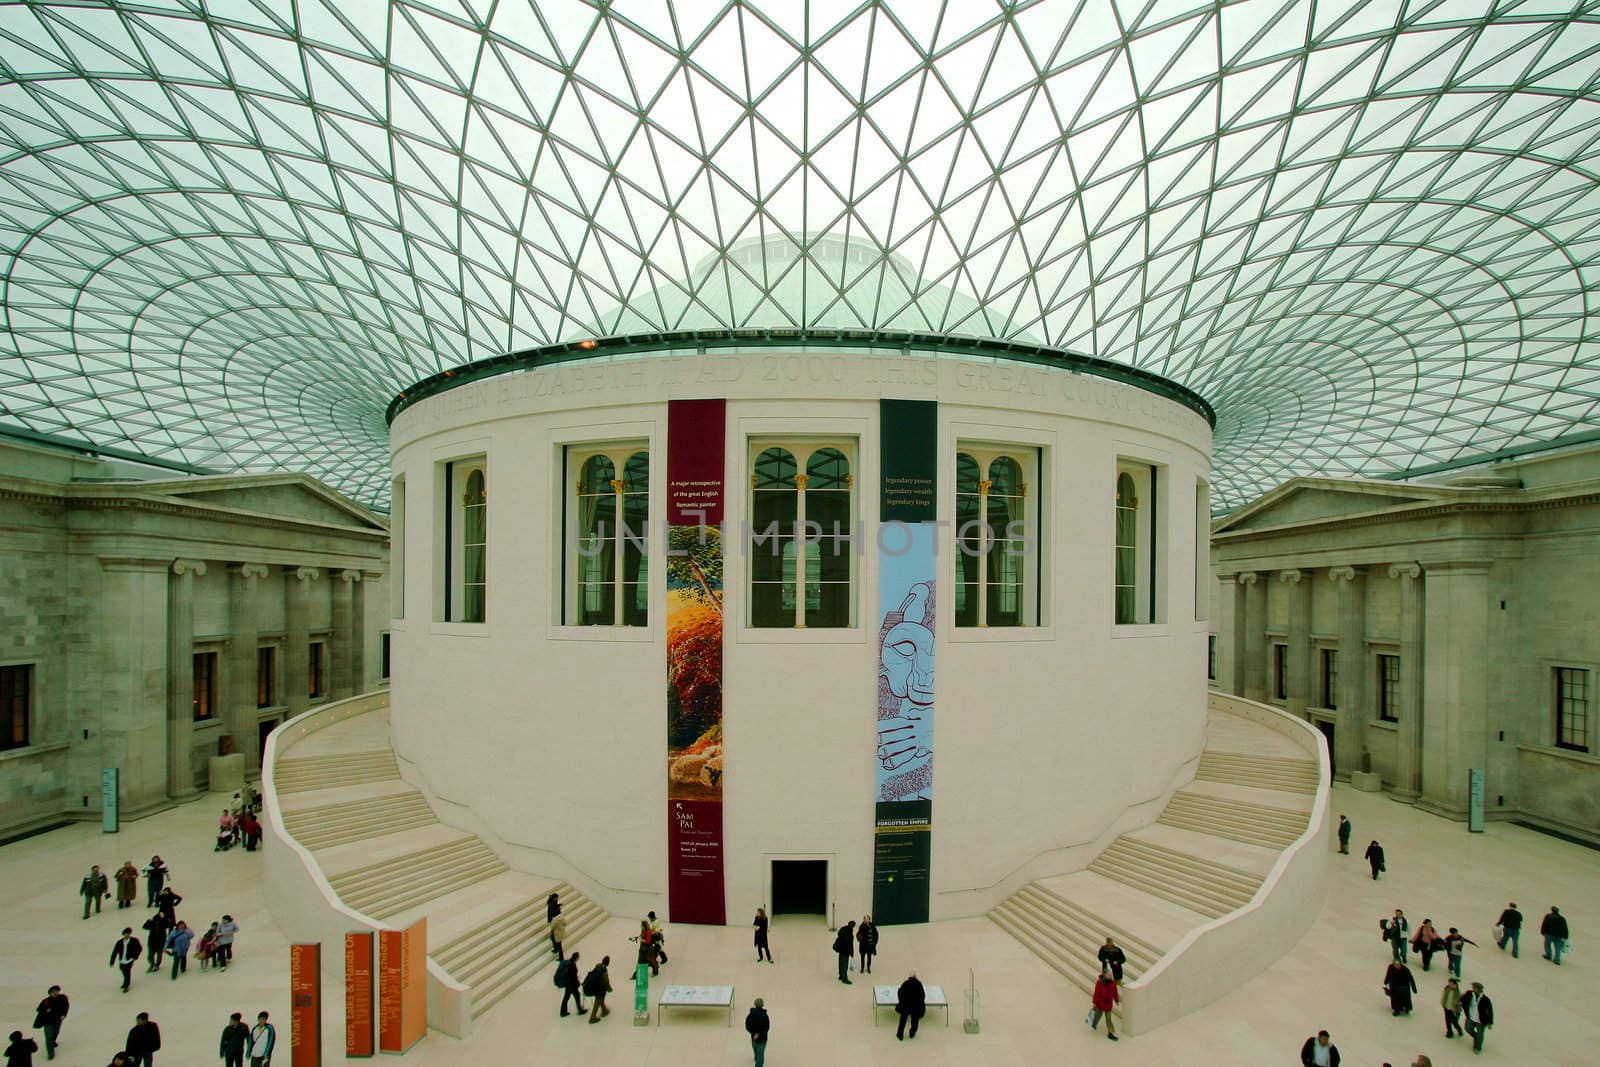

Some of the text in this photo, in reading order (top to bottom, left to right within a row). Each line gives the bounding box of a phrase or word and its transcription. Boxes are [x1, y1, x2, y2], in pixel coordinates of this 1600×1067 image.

[761, 355, 849, 382] 2000
[863, 357, 937, 385] THIS
[955, 362, 1049, 398] GREAT
[292, 946, 303, 974] today
[345, 949, 355, 981] Hands
